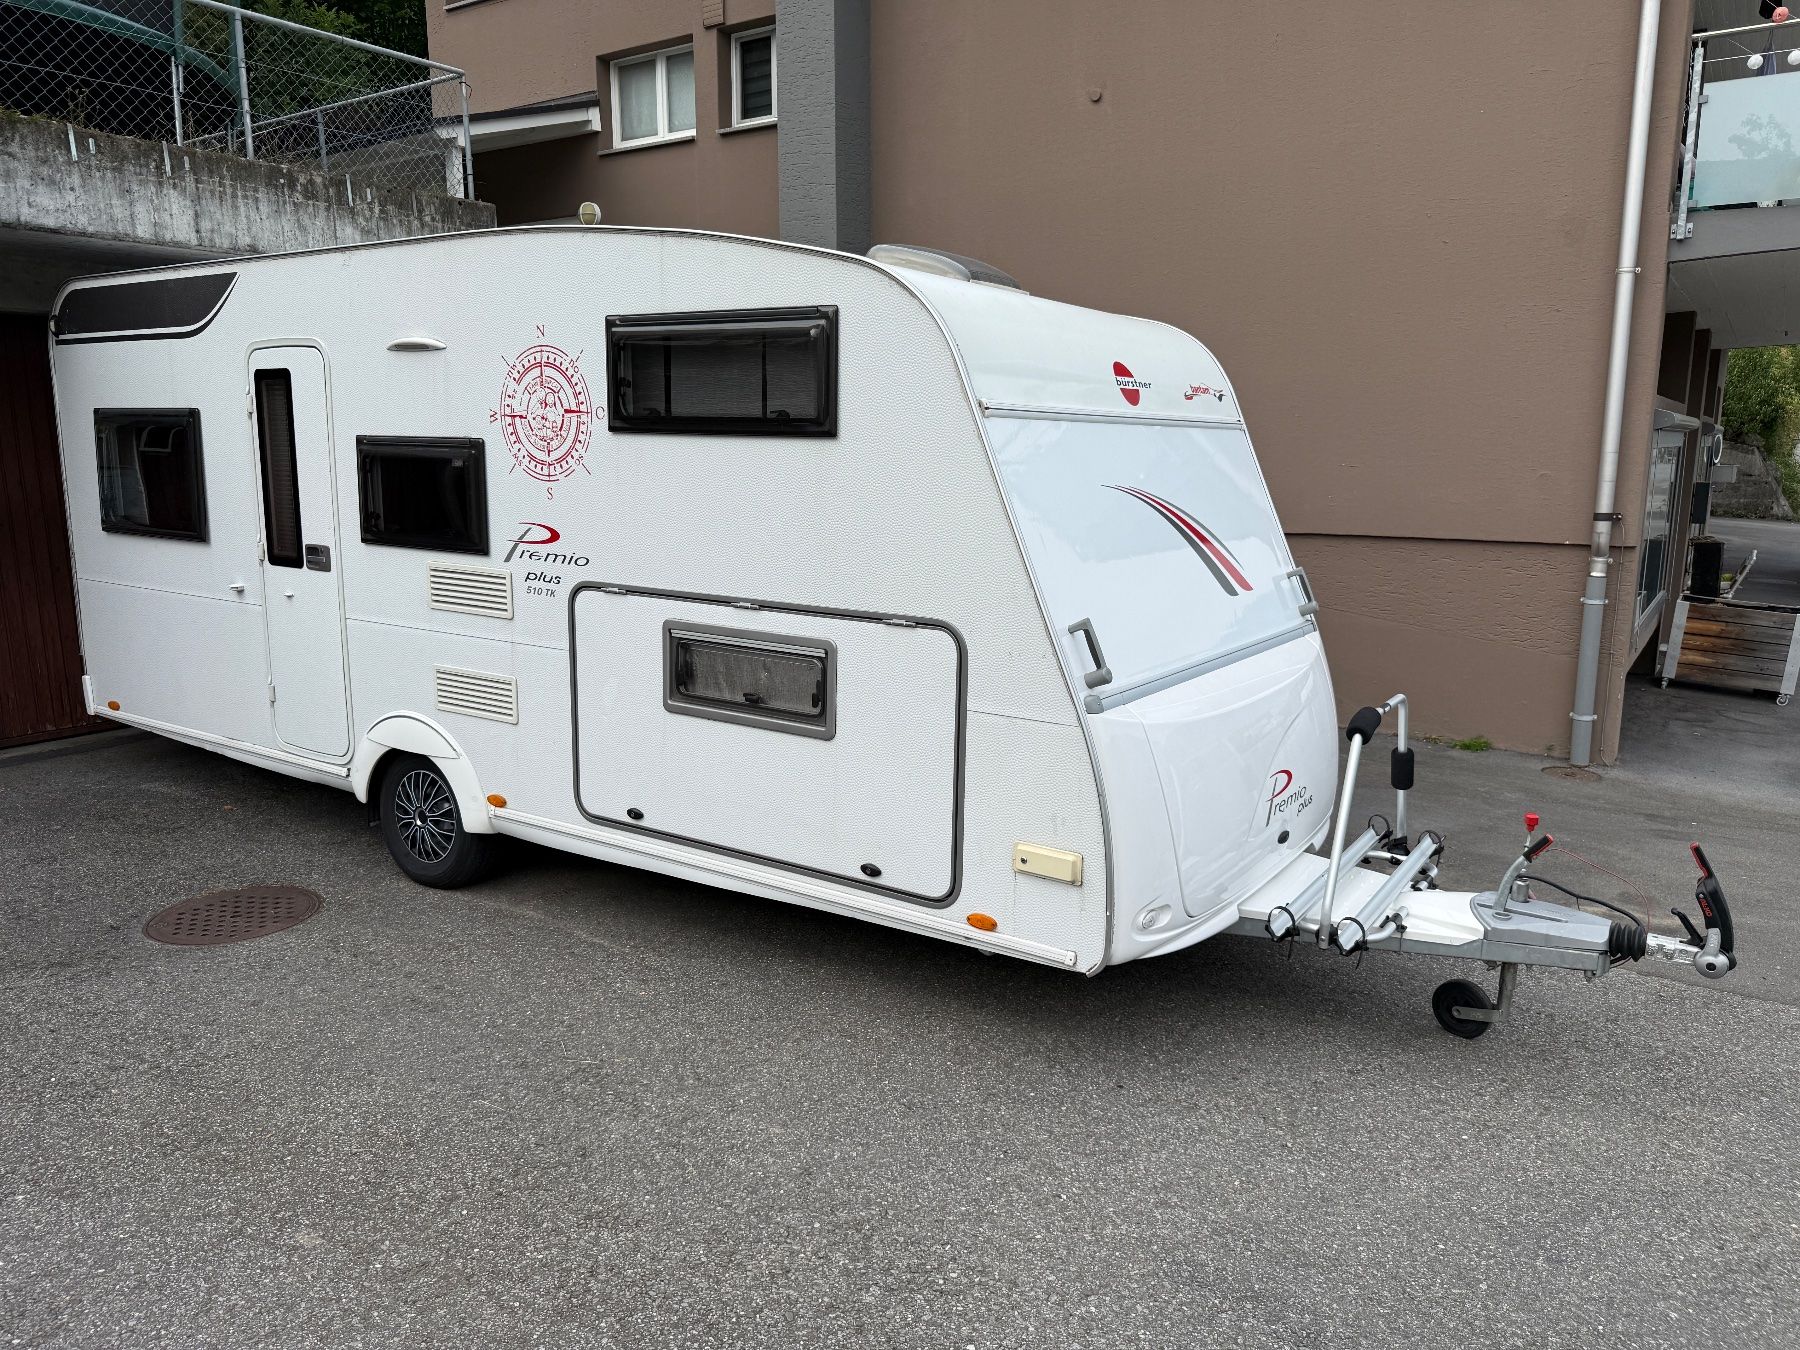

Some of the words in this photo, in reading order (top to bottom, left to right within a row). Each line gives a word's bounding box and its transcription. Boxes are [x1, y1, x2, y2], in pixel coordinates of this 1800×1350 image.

[536, 324, 545, 338] N
[1115, 377, 1152, 389] bürstner
[546, 487, 553, 500] S
[503, 522, 590, 567] Premio
[524, 571, 561, 585] plus
[526, 585, 543, 596] 510
[545, 588, 557, 598] TK
[1265, 769, 1307, 828] Premio
[1296, 794, 1313, 817] plus
